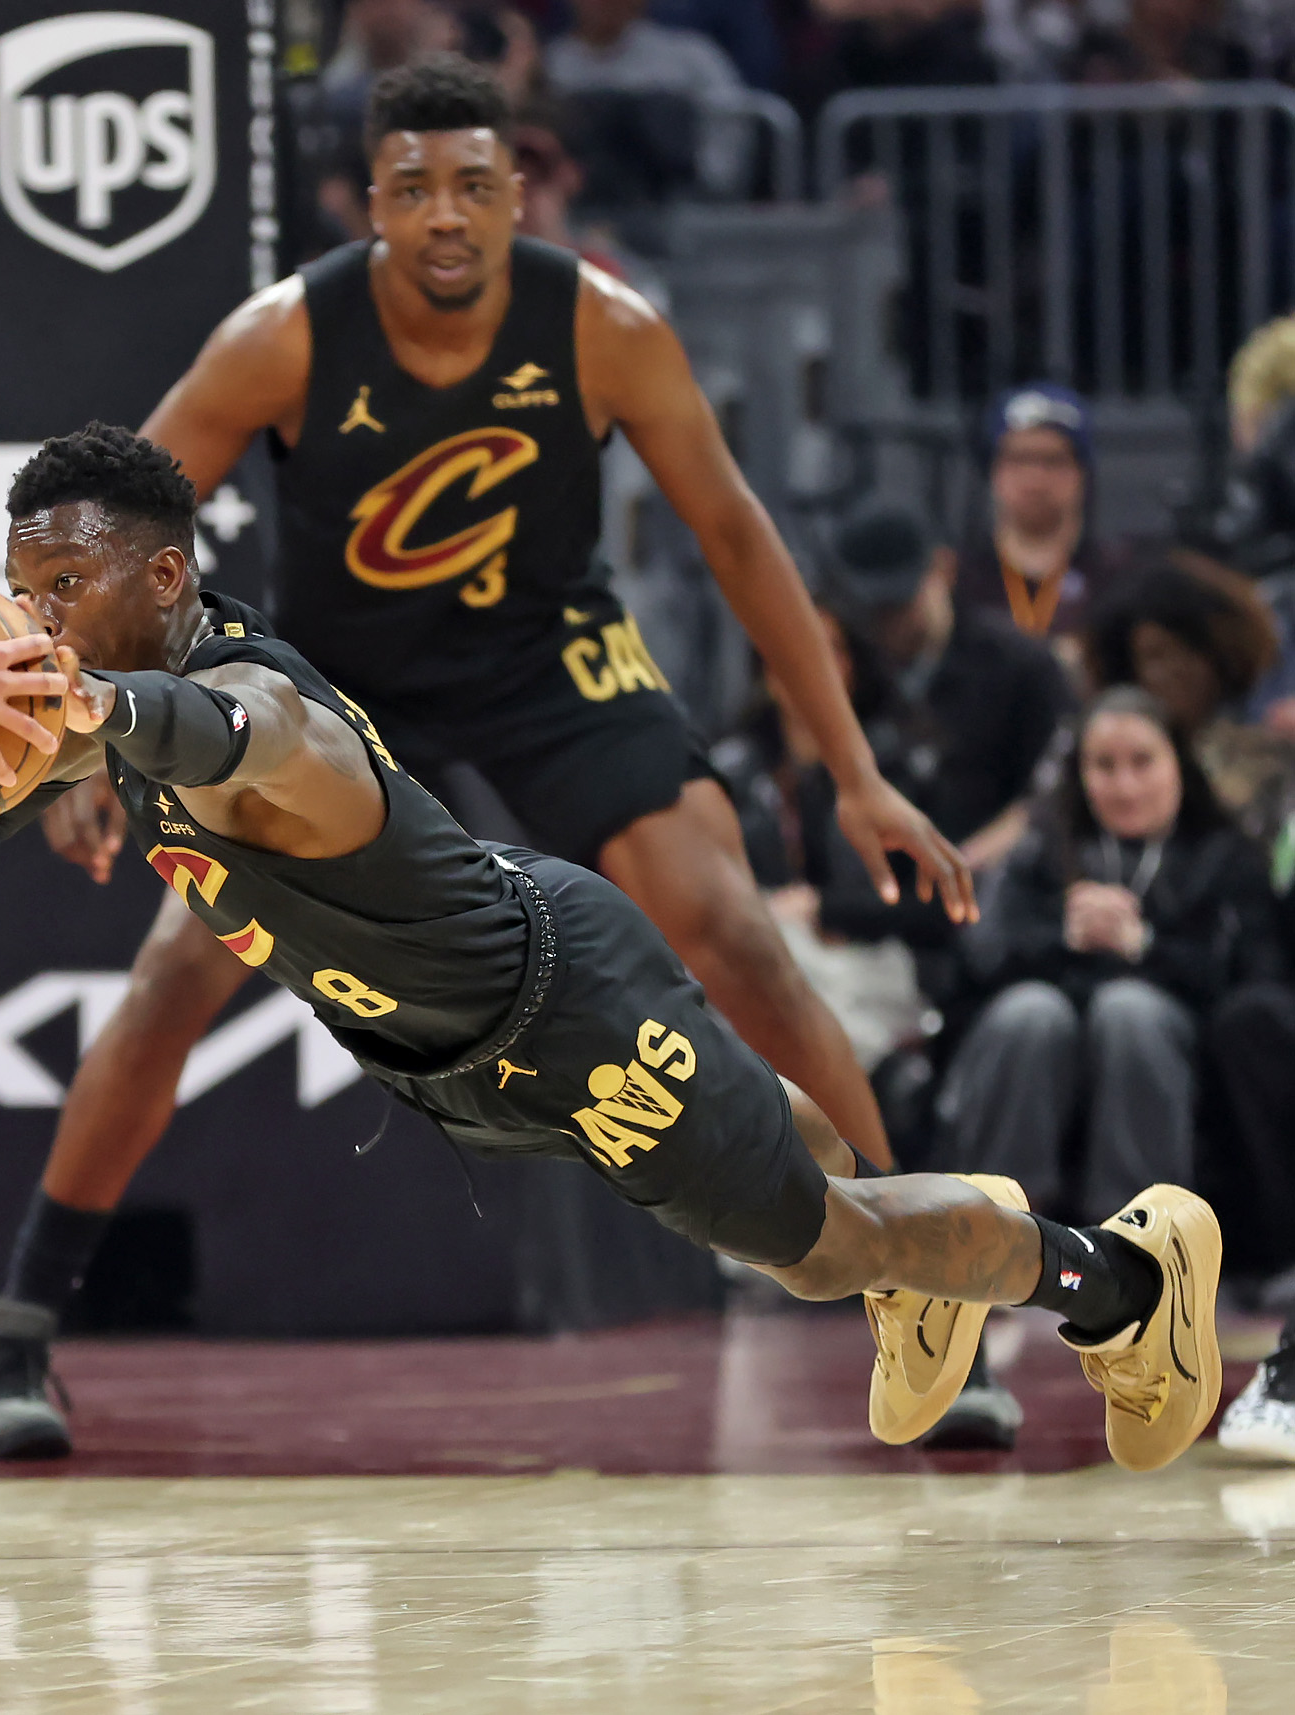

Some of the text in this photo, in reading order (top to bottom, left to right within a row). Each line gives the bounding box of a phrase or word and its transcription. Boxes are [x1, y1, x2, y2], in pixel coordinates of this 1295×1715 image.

[18, 90, 193, 230] ups
[159, 820, 196, 837] CLIFFS
[311, 968, 399, 1018] 8
[569, 1018, 697, 1168] AVS
